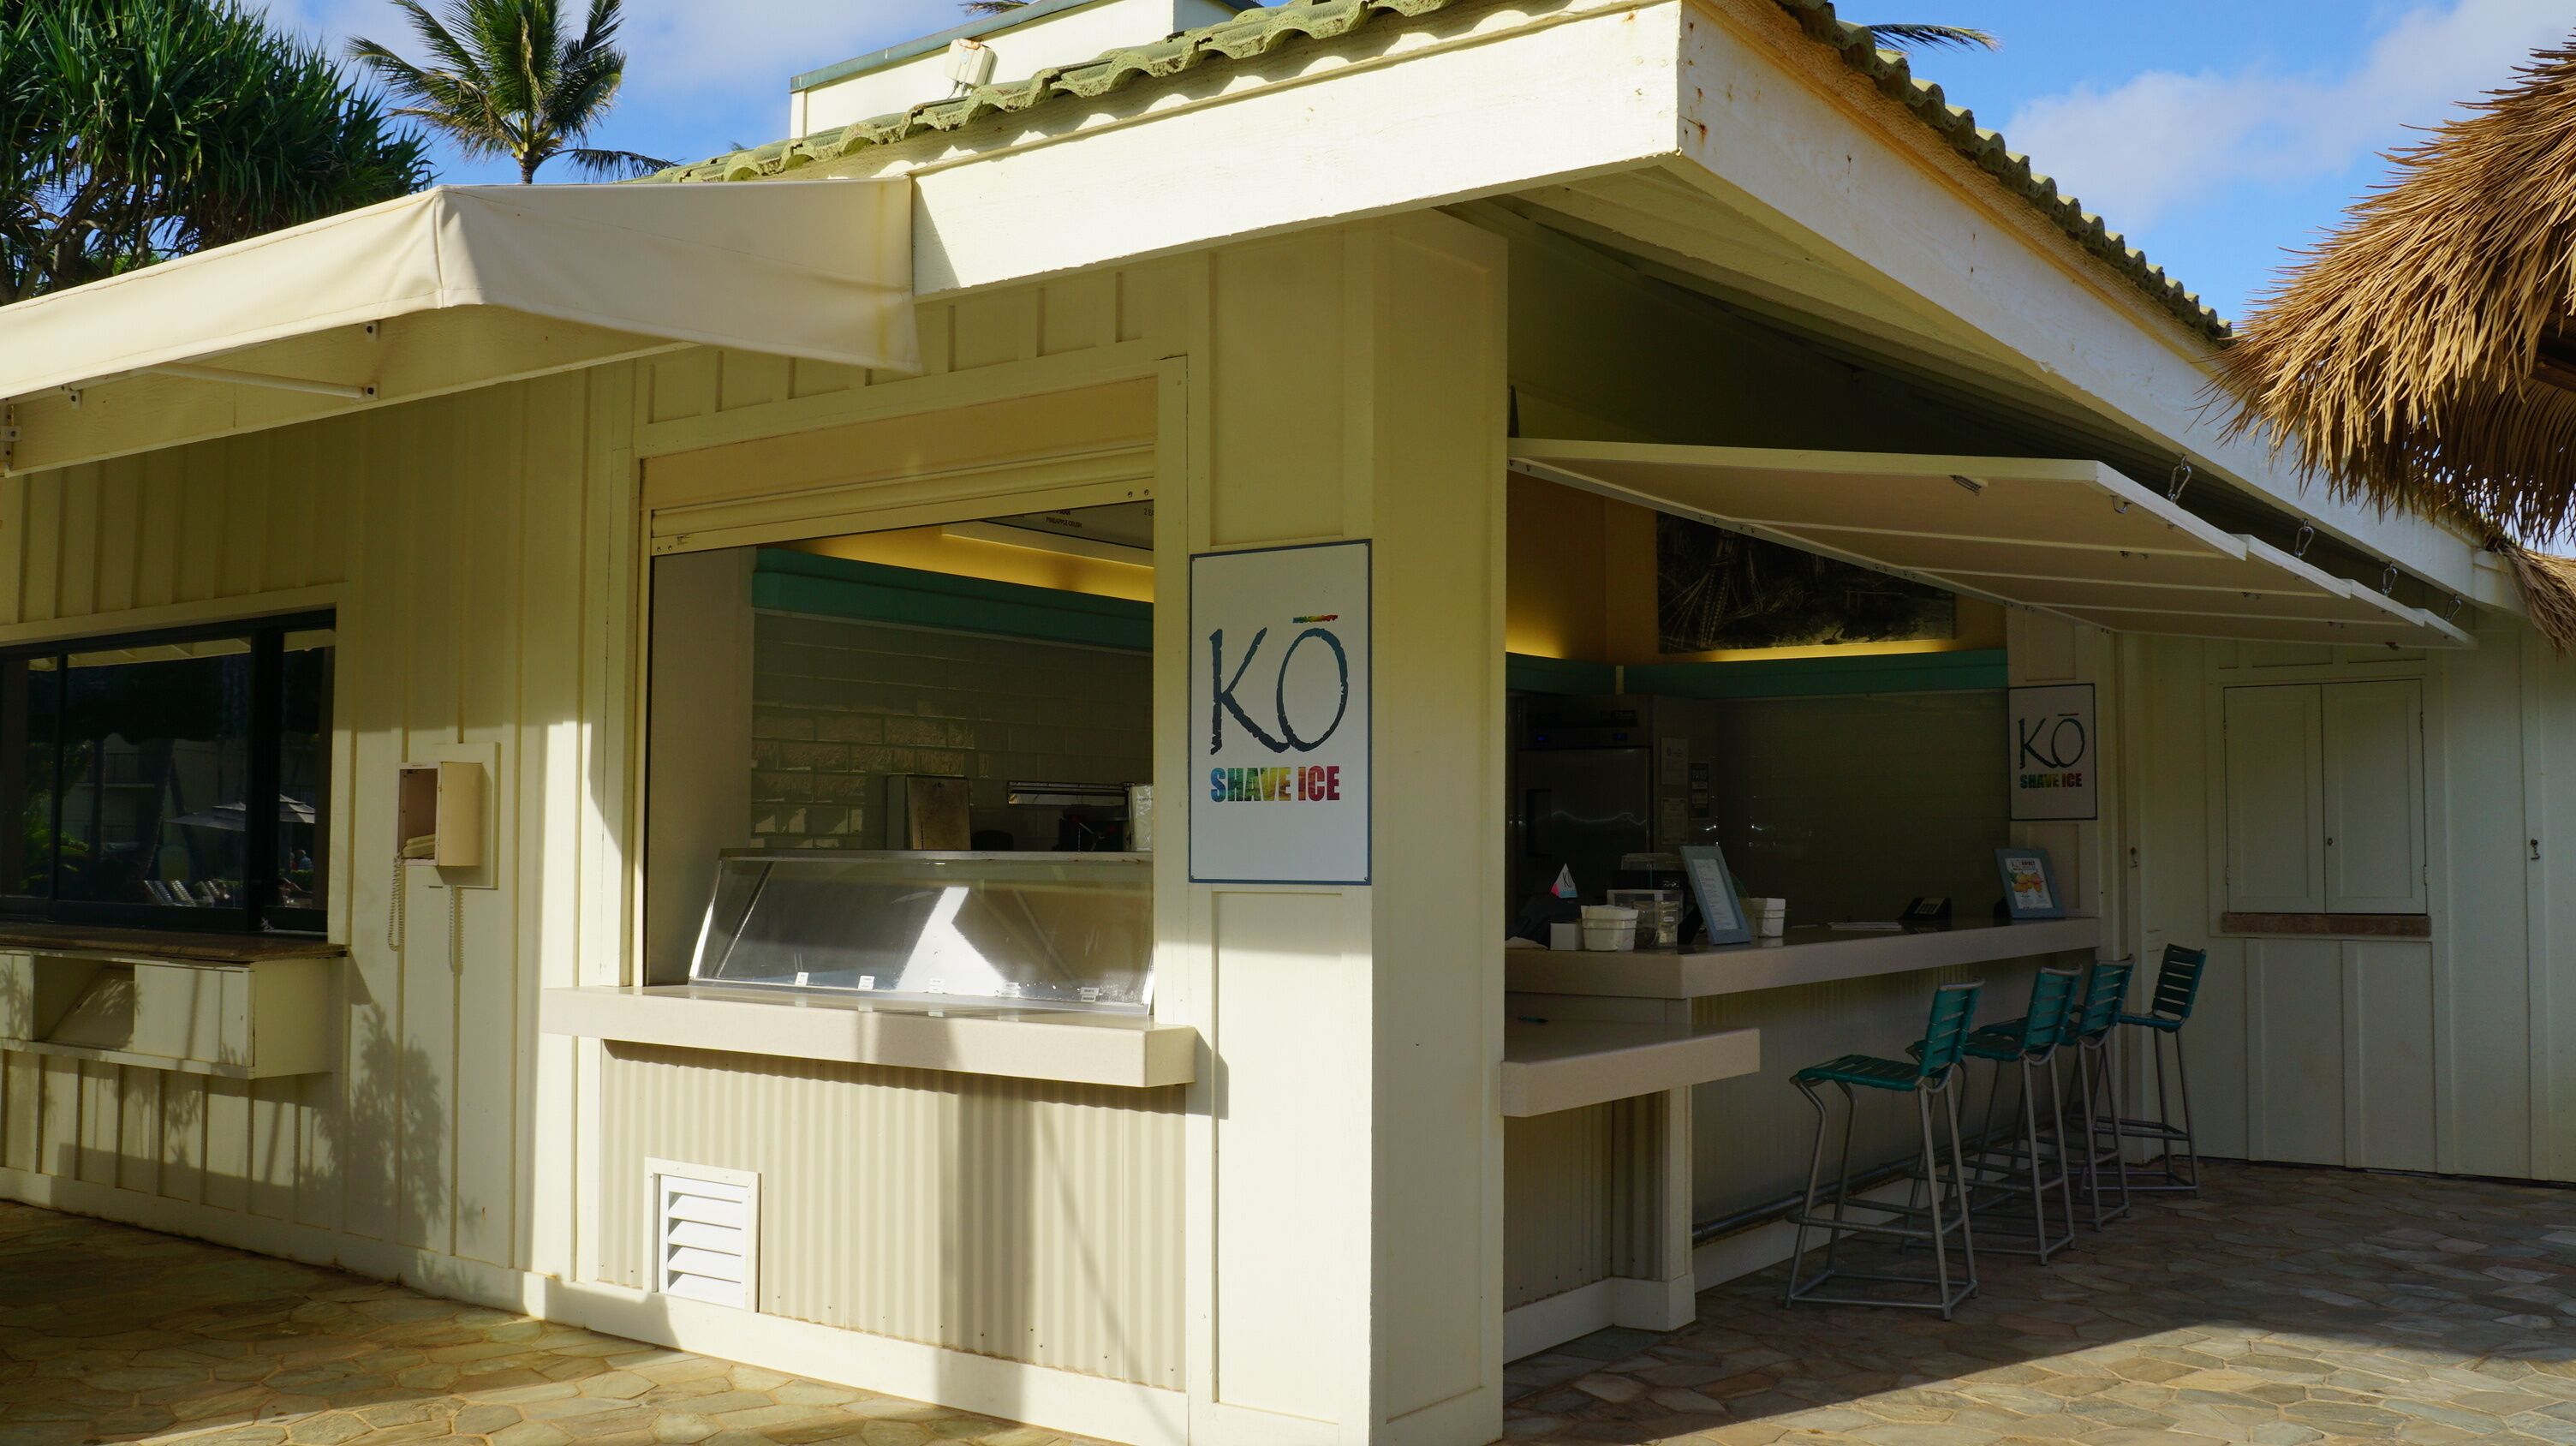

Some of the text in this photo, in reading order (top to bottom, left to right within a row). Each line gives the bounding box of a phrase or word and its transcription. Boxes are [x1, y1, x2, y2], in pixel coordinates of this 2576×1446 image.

[1209, 614, 1349, 756] KŌ
[2018, 713, 2085, 770] KŌ
[1210, 765, 1340, 803] SHAVE ICE
[2019, 773, 2083, 789] SHAVE ICE
